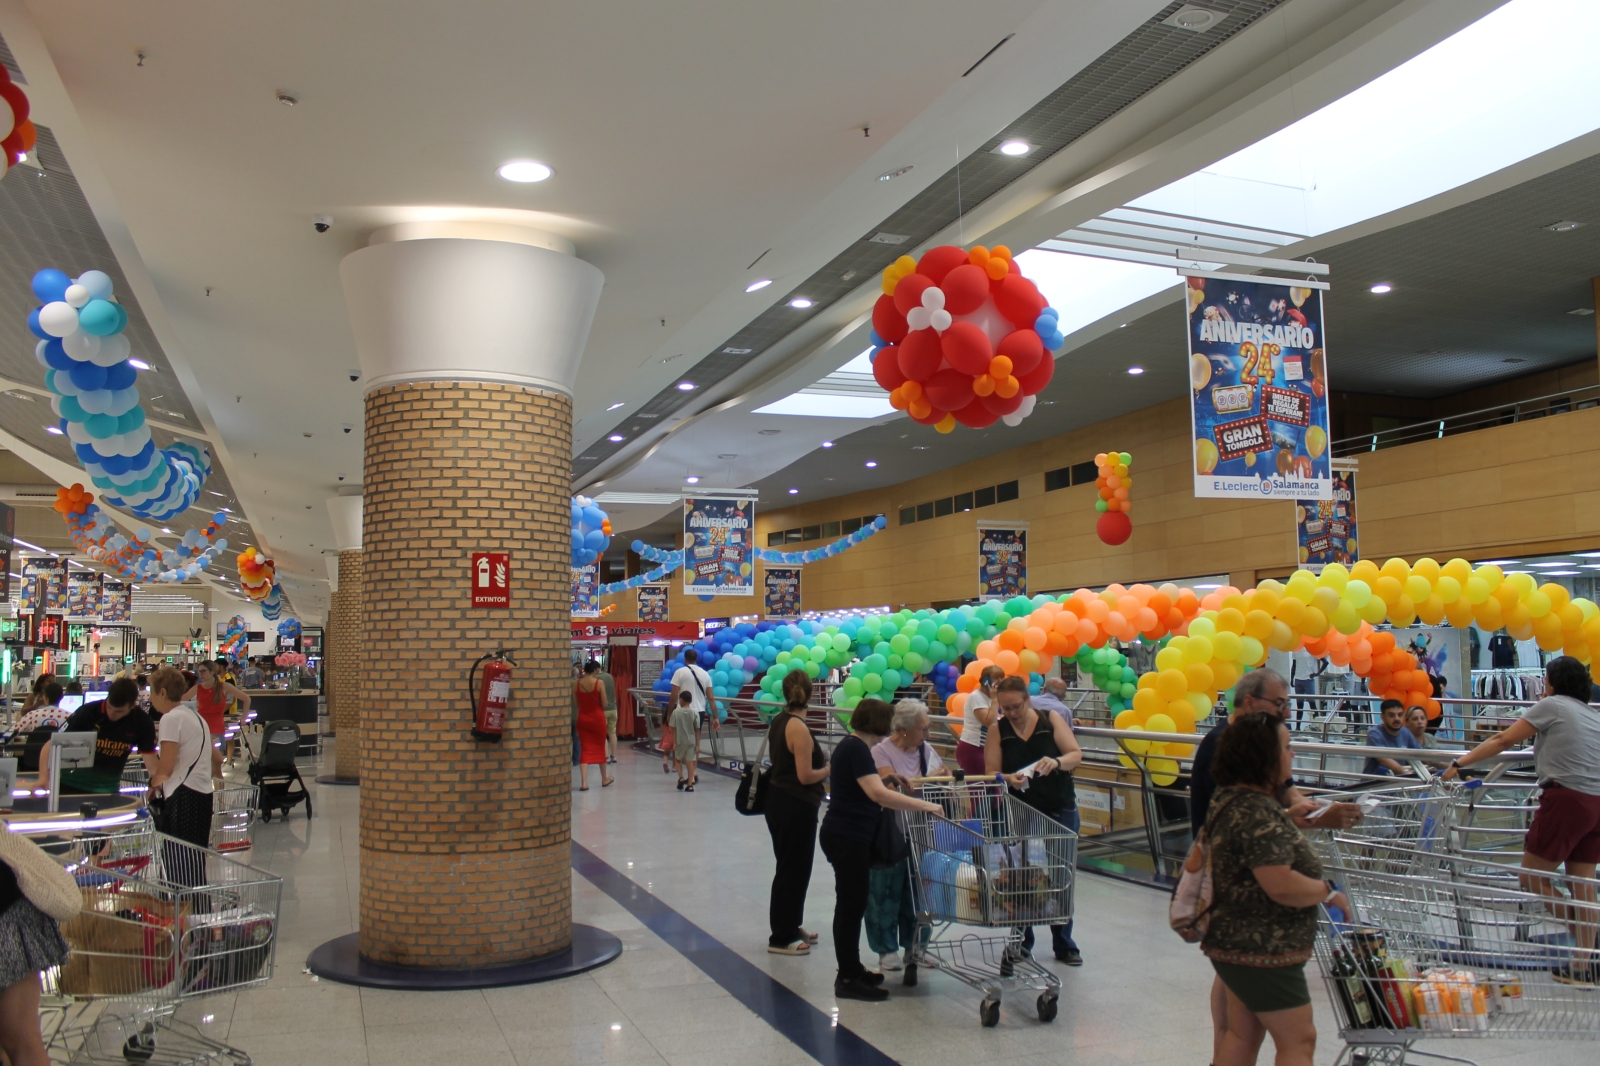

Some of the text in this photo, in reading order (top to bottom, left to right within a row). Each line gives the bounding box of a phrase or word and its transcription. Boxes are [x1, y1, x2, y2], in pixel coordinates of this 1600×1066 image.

[1200, 319, 1314, 350] ANIVERSARIO
[1272, 400, 1298, 410] REGALOS
[1223, 424, 1262, 443] GRAN
[1214, 482, 1258, 491] E.Leclerc
[1273, 480, 1319, 490] Salamanca
[690, 517, 748, 528] ANIVERSARIO
[698, 562, 718, 572] GRAN
[586, 625, 608, 636] 365
